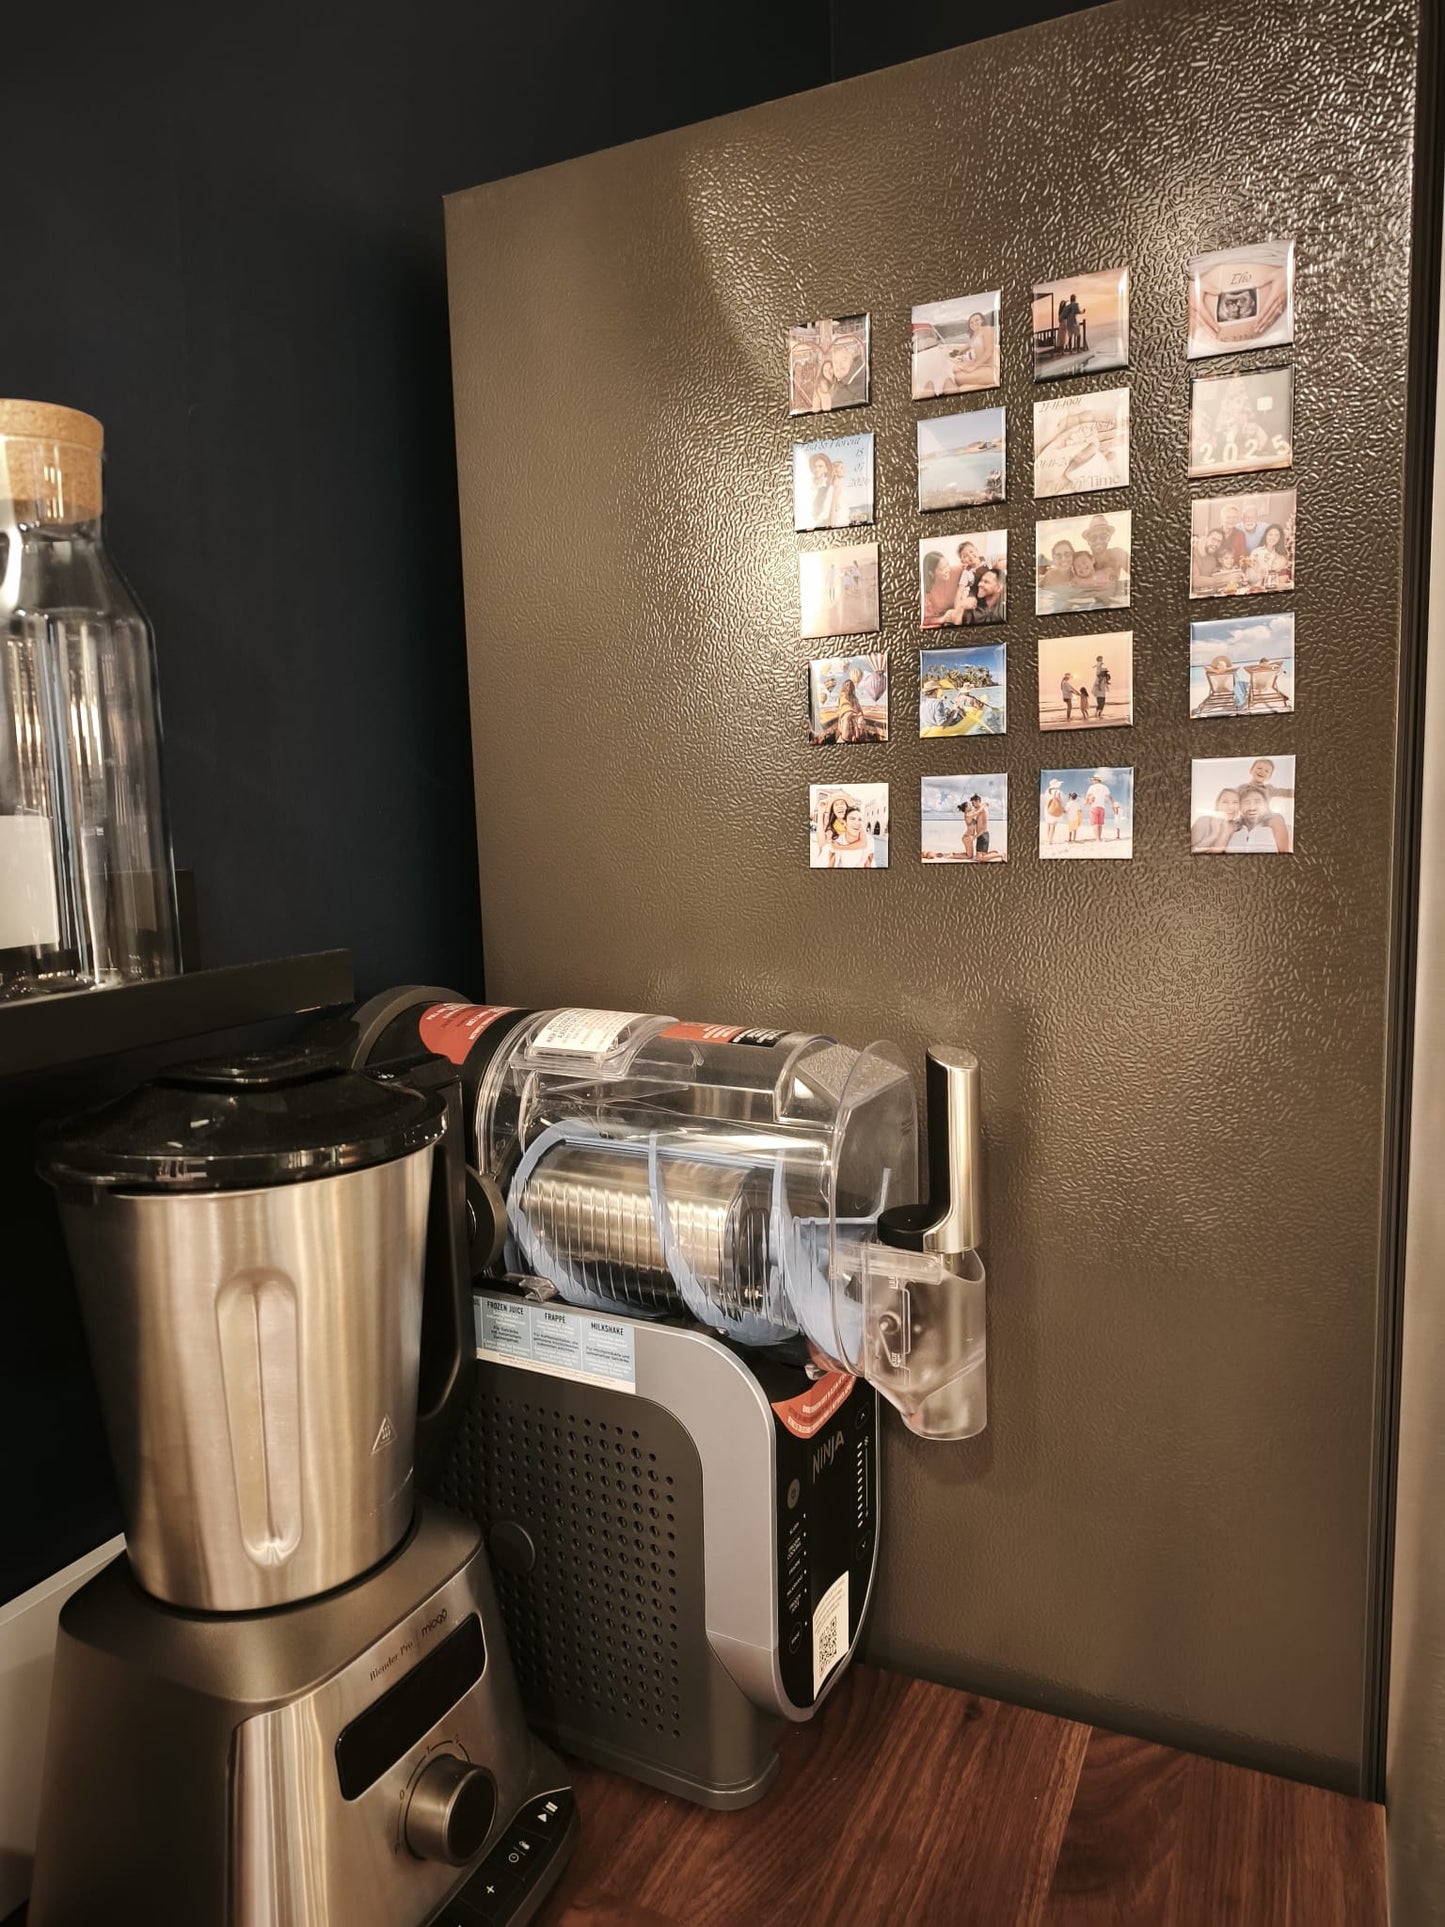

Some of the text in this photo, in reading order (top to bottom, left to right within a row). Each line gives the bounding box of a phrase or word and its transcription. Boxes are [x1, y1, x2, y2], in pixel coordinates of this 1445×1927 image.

[486, 1301, 508, 1313] FROZEN
[508, 1305, 524, 1316] JUICE
[590, 1322, 624, 1336] MILKSHAKE
[812, 1430, 845, 1485] NINJA
[369, 1653, 399, 1682] Blender
[400, 1641, 413, 1656] Pro
